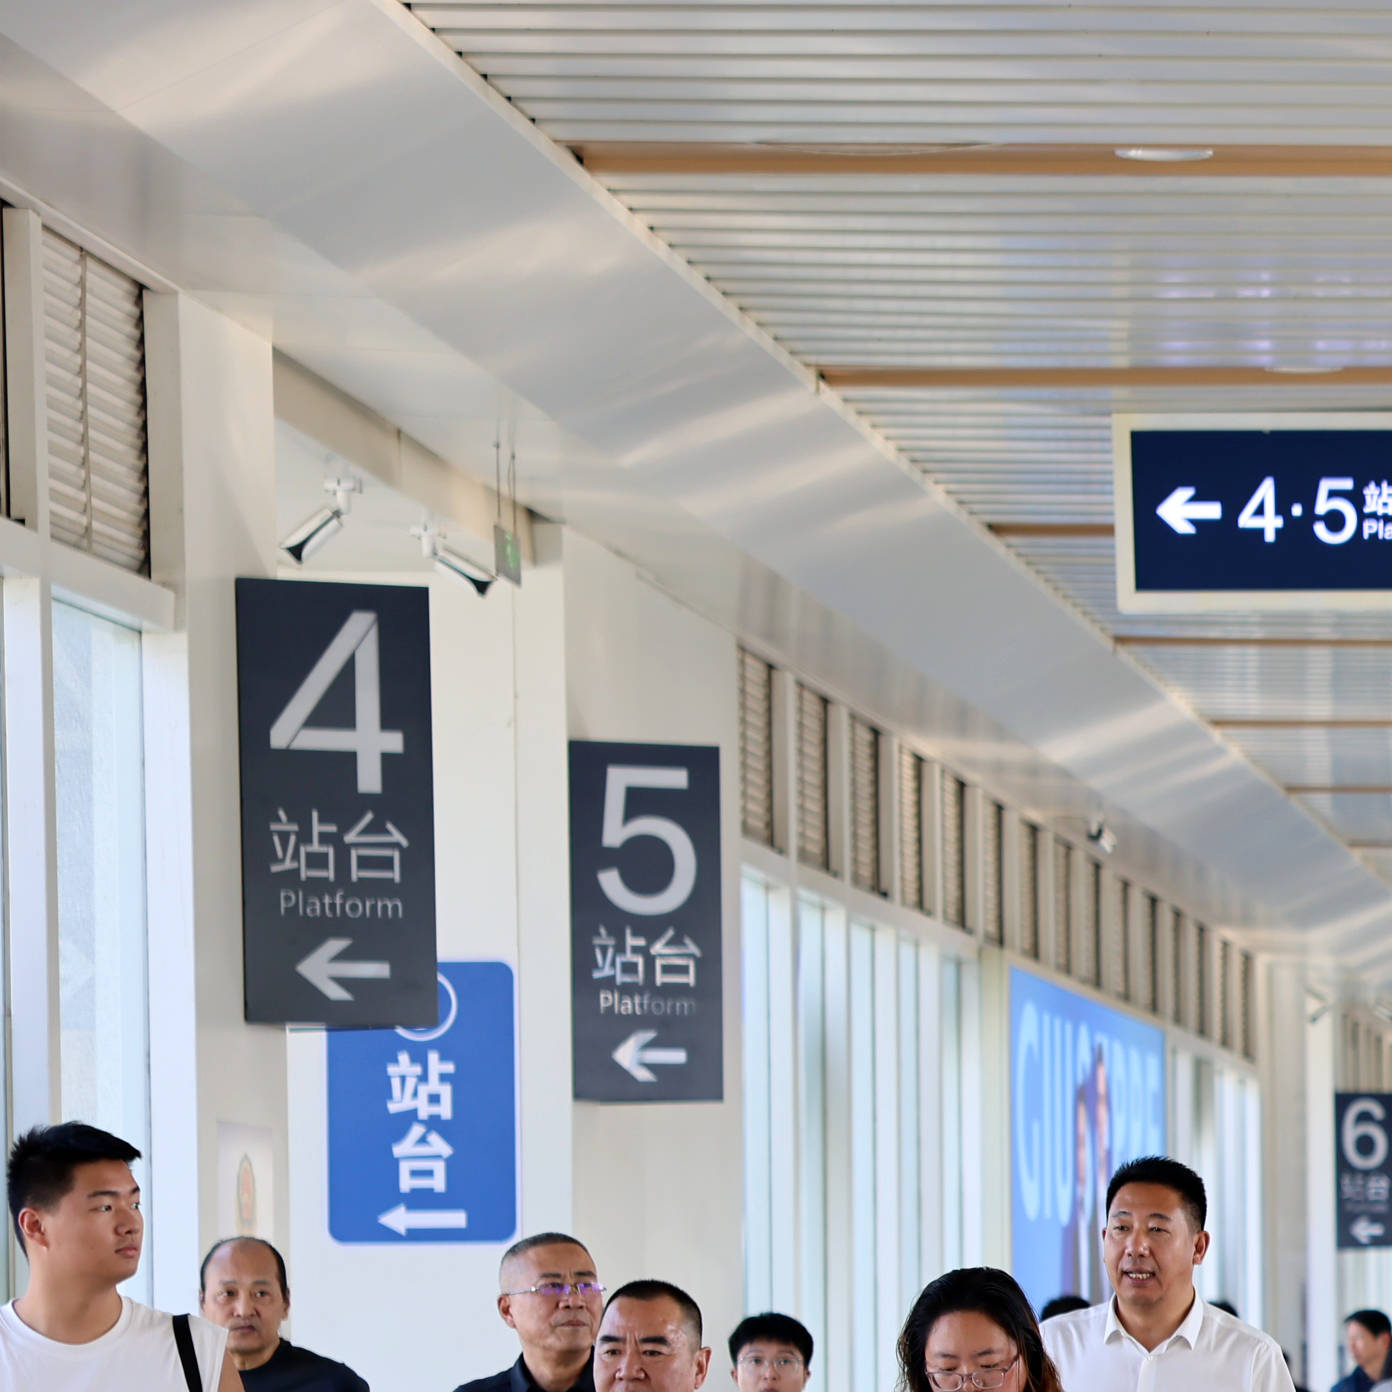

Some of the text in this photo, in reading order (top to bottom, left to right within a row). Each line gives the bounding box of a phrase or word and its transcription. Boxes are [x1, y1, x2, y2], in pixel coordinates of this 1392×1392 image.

[270, 611, 404, 794] 4
[269, 809, 409, 884] 站台
[597, 765, 697, 916] 5
[280, 889, 403, 919] Platform
[592, 927, 703, 987] 站台
[599, 989, 697, 1016] Platform
[386, 1051, 456, 1193] 站台
[1341, 1096, 1390, 1170] 6
